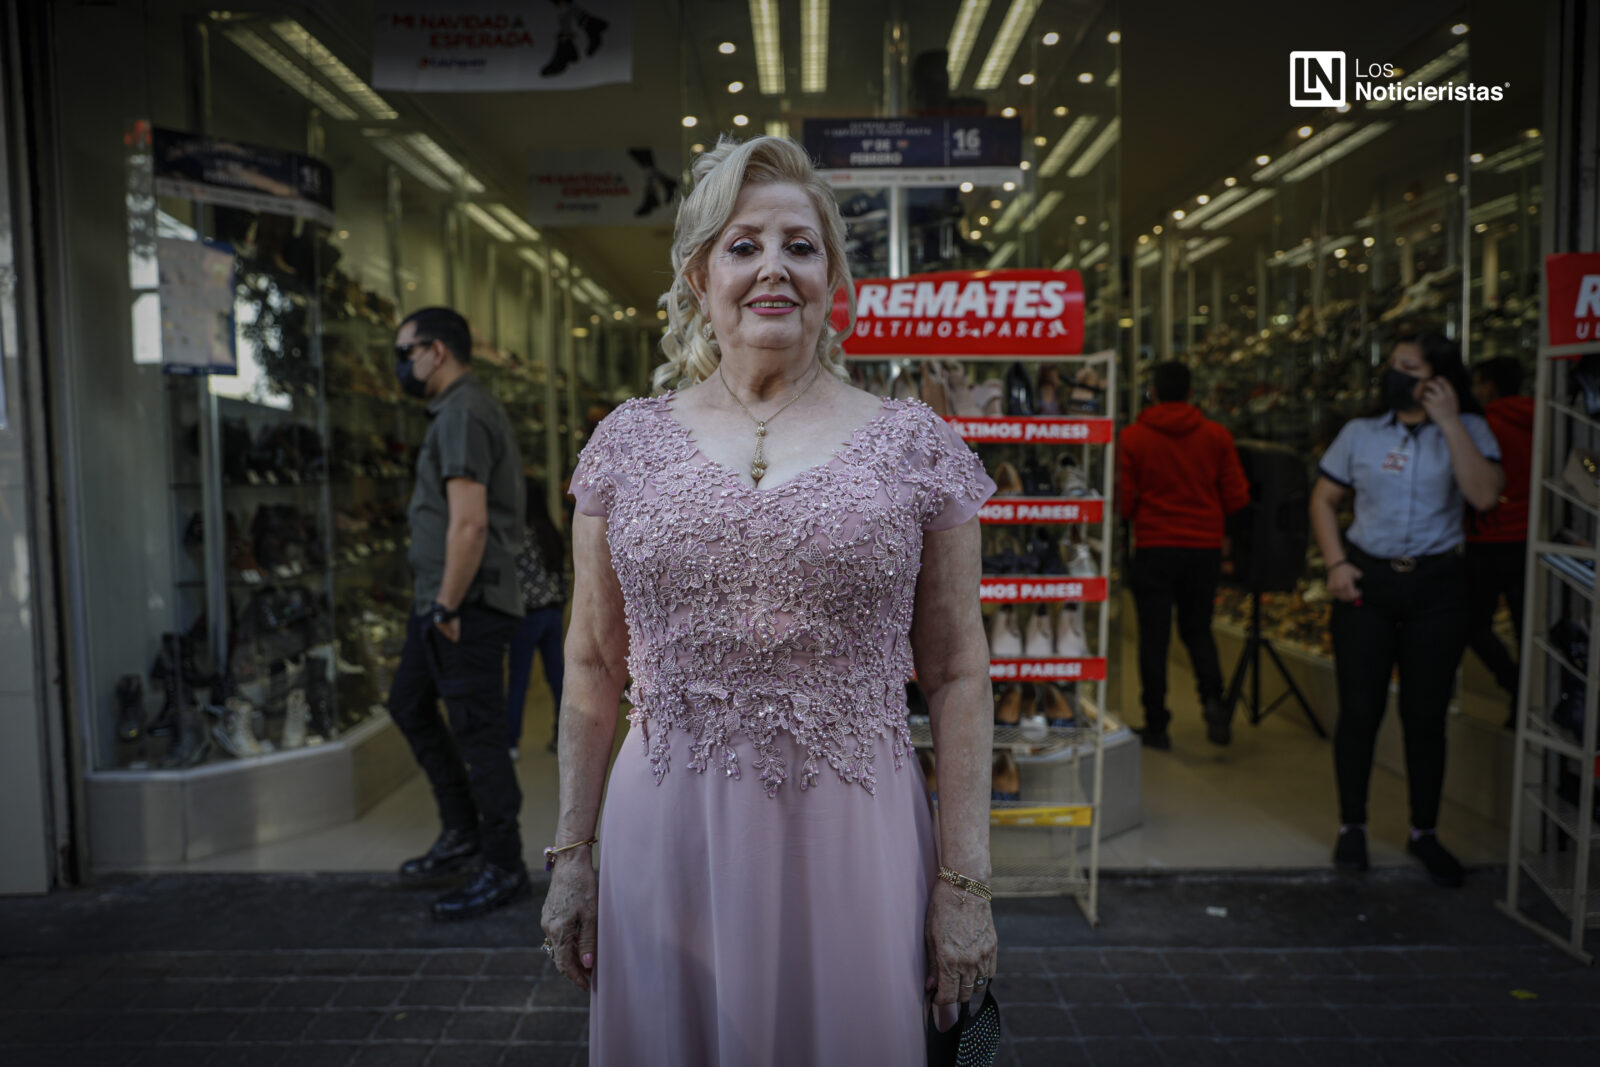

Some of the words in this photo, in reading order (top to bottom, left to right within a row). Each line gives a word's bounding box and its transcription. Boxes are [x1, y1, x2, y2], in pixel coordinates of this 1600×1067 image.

[392, 14, 416, 29] MI
[418, 14, 508, 30] NAVIDAD
[429, 31, 535, 48] ESPERADA
[952, 128, 982, 150] 16
[856, 280, 1068, 318] REMATES
[856, 320, 970, 339] ULTIMOS
